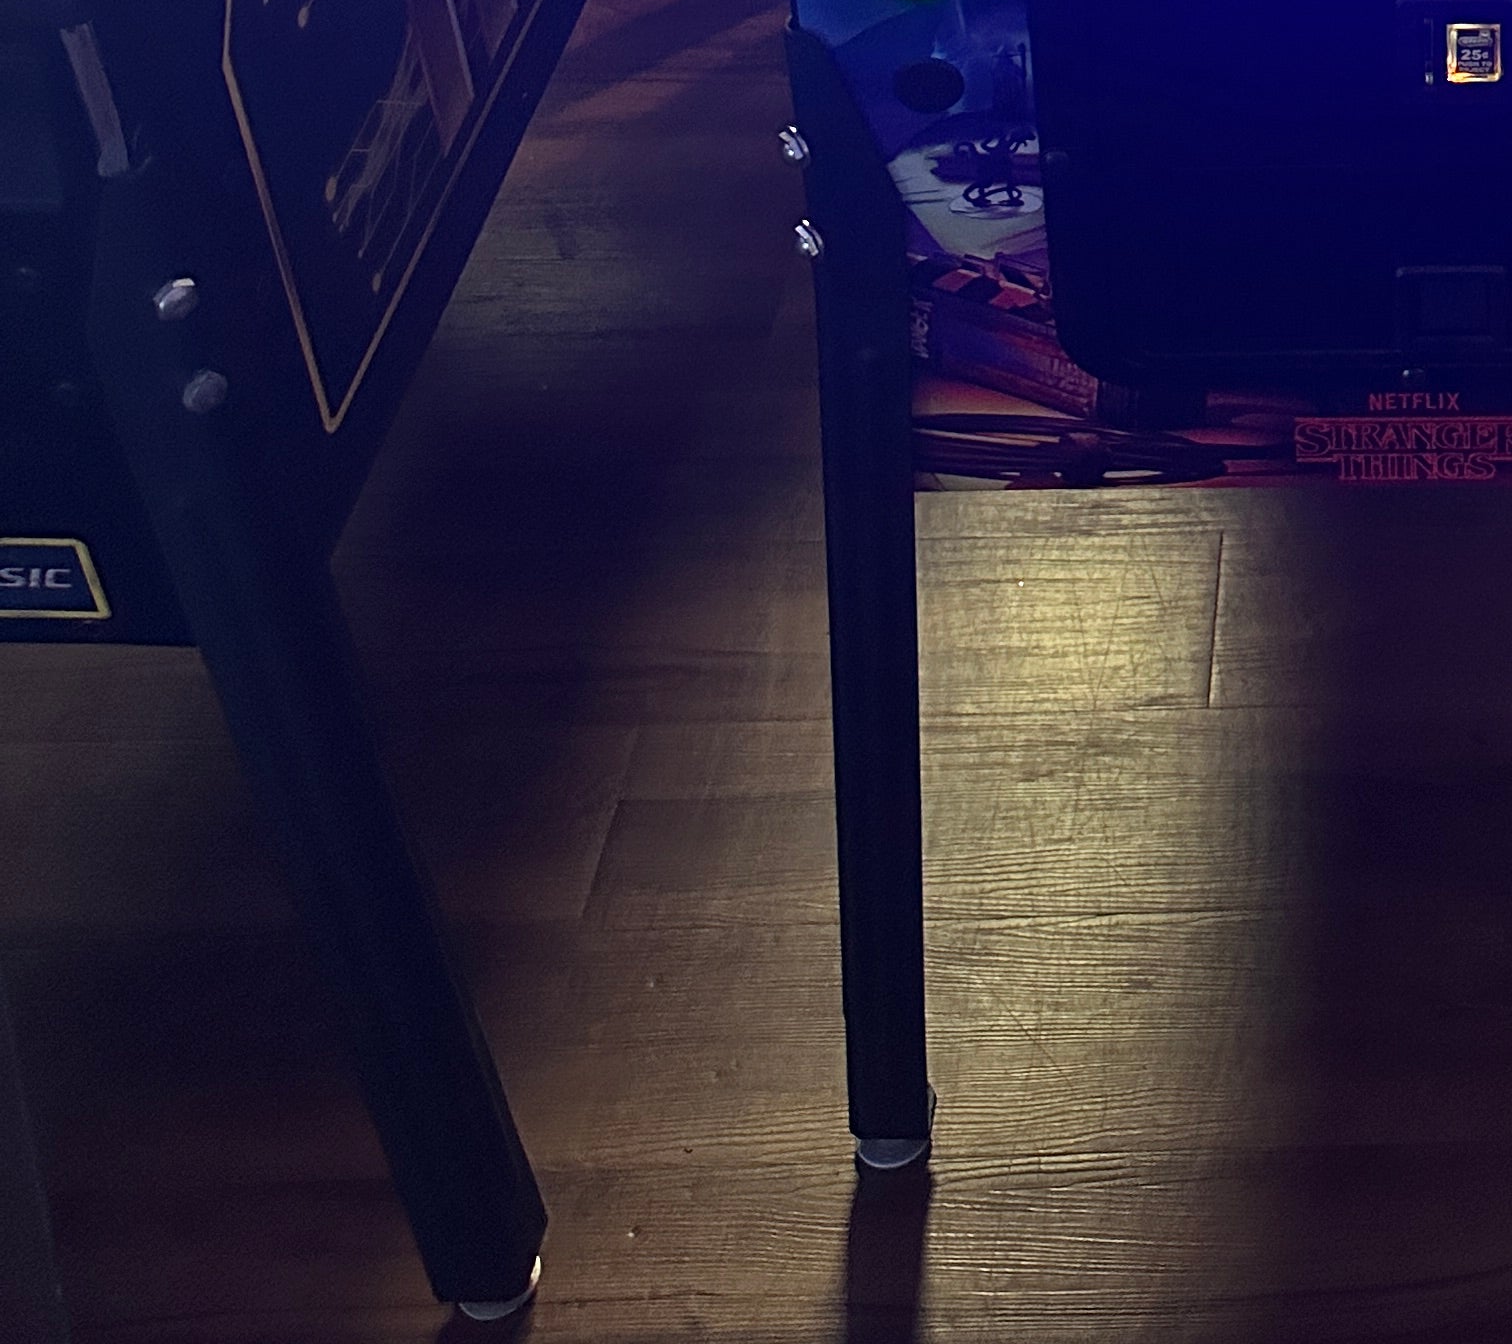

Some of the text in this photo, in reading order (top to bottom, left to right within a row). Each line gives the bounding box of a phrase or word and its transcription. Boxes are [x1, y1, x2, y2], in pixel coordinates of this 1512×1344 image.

[1460, 49, 1489, 61] 25¢
[1369, 392, 1460, 411] NETFLIX
[1333, 452, 1496, 481] THINGS
